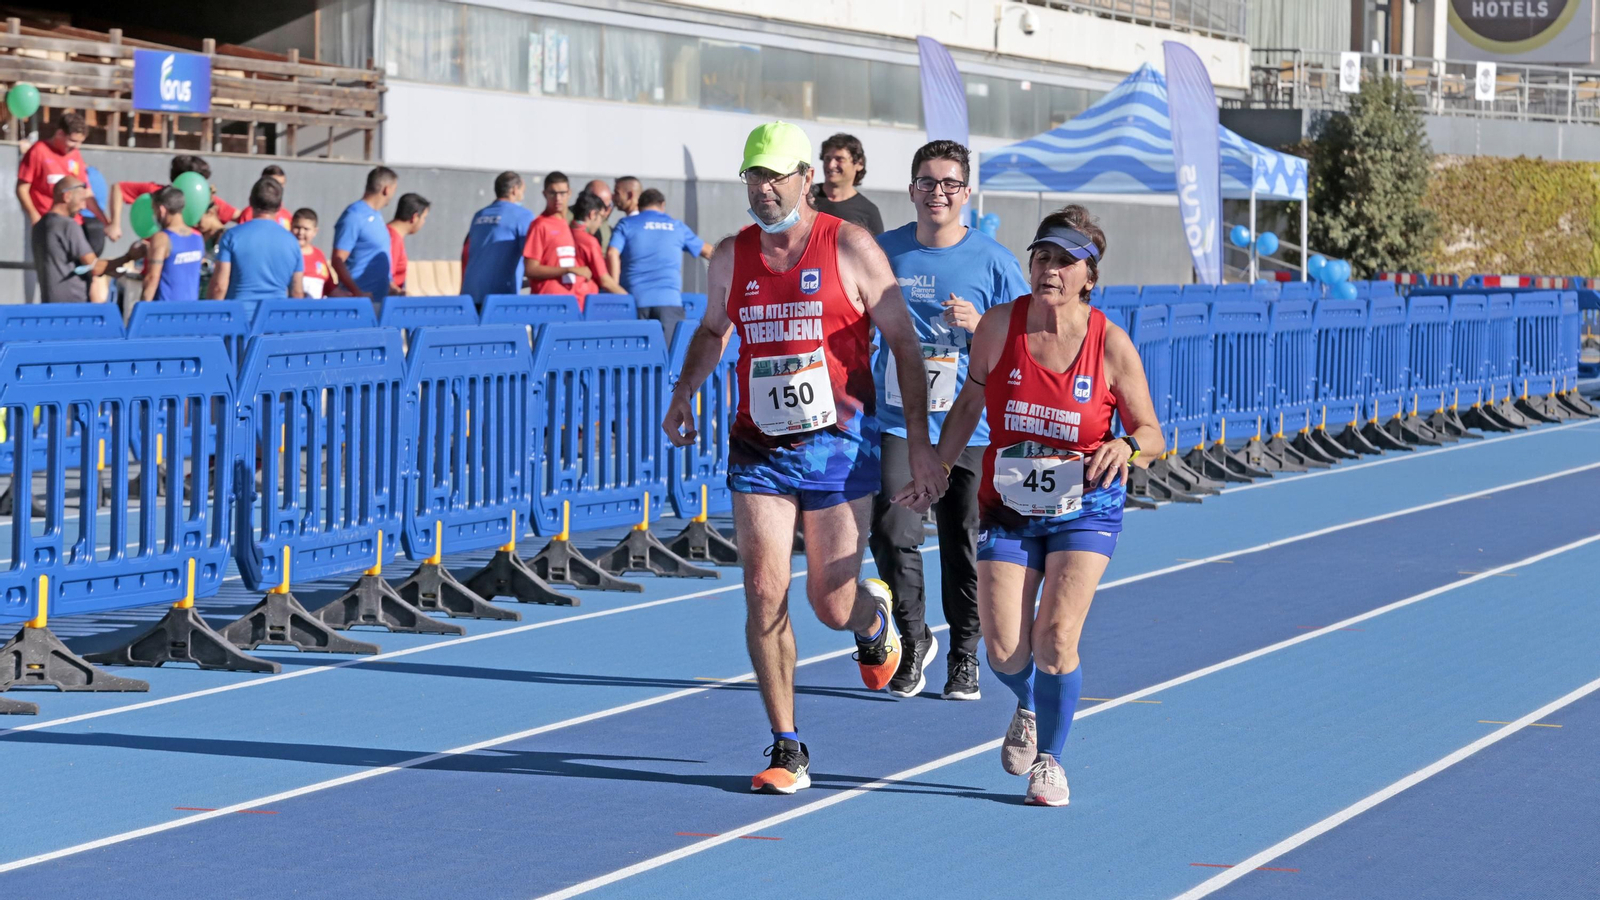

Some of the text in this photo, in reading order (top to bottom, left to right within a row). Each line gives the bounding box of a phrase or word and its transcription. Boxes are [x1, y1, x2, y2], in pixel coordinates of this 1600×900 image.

[1472, 2, 1548, 17] HOTELS
[643, 221, 675, 231] JEREZ
[912, 275, 935, 287] XLI
[739, 301, 823, 322] CLUB ATLETISMO
[744, 318, 823, 344] TREBUJENA
[768, 382, 814, 410] 150
[1005, 400, 1081, 425] CLUB ATLETISMO
[1004, 414, 1079, 443] TREBUJENA
[1023, 469, 1056, 493] 45
